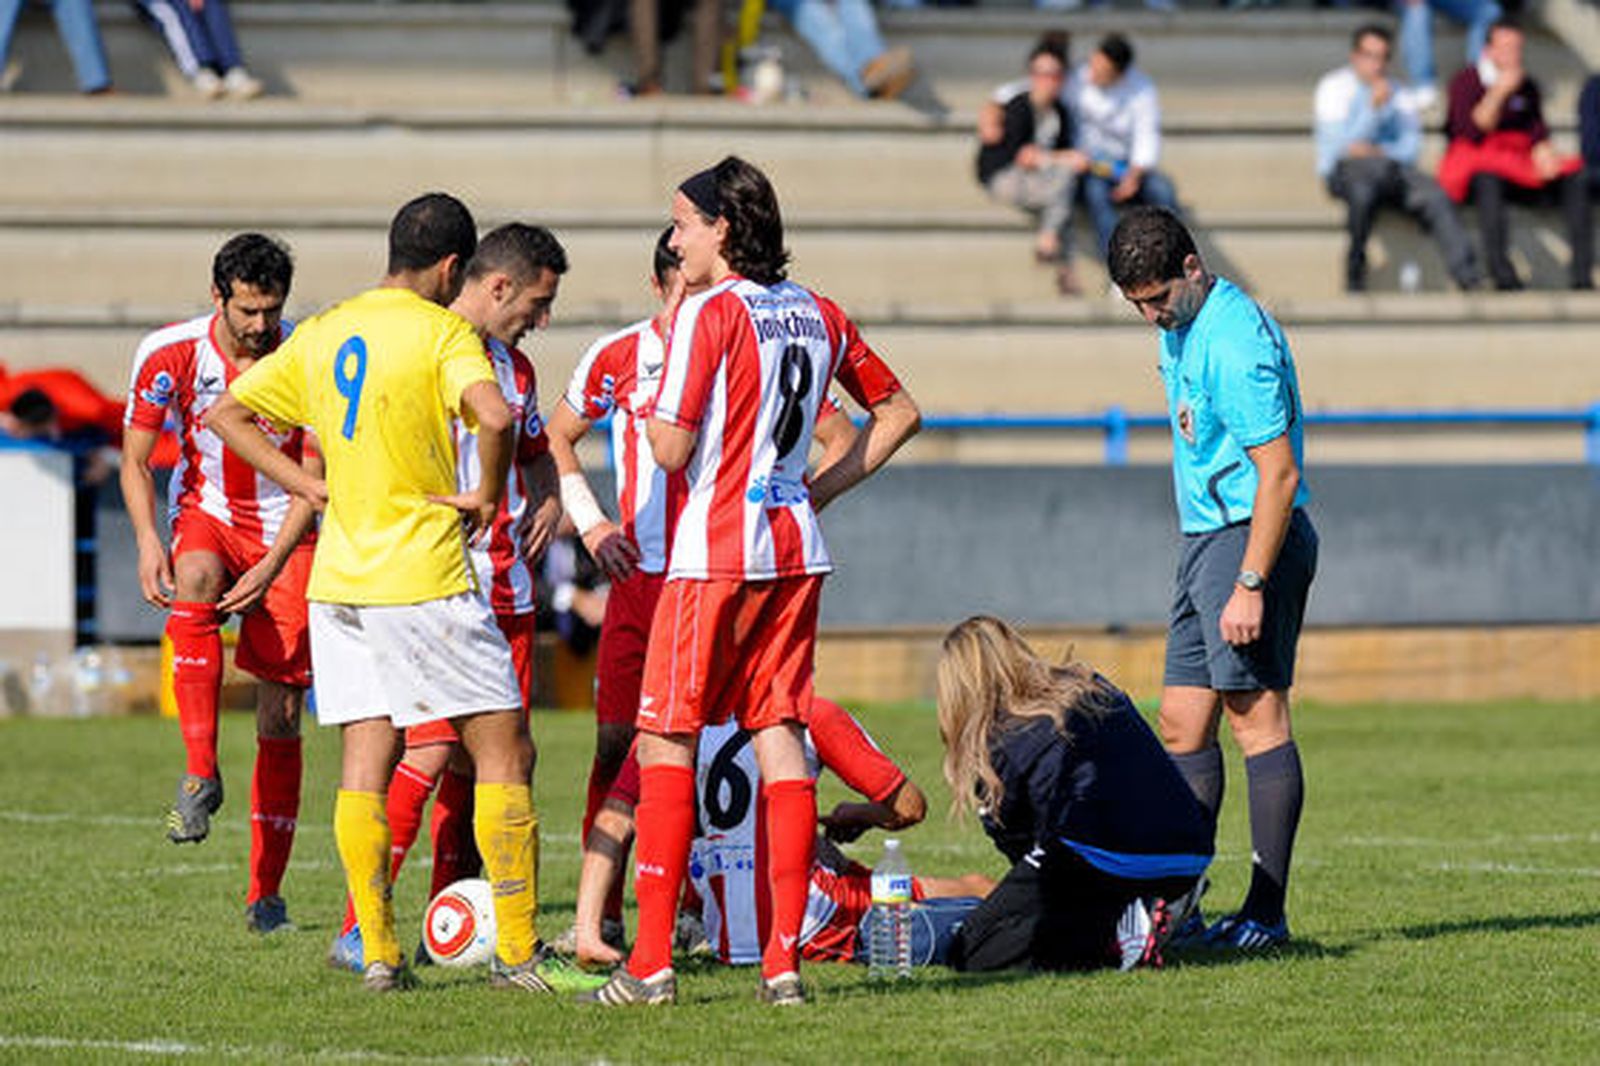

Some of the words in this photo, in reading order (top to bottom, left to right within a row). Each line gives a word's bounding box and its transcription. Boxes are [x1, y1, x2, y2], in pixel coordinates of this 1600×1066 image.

[334, 335, 367, 441] 9
[772, 343, 813, 461] 8
[703, 729, 752, 831] 6
